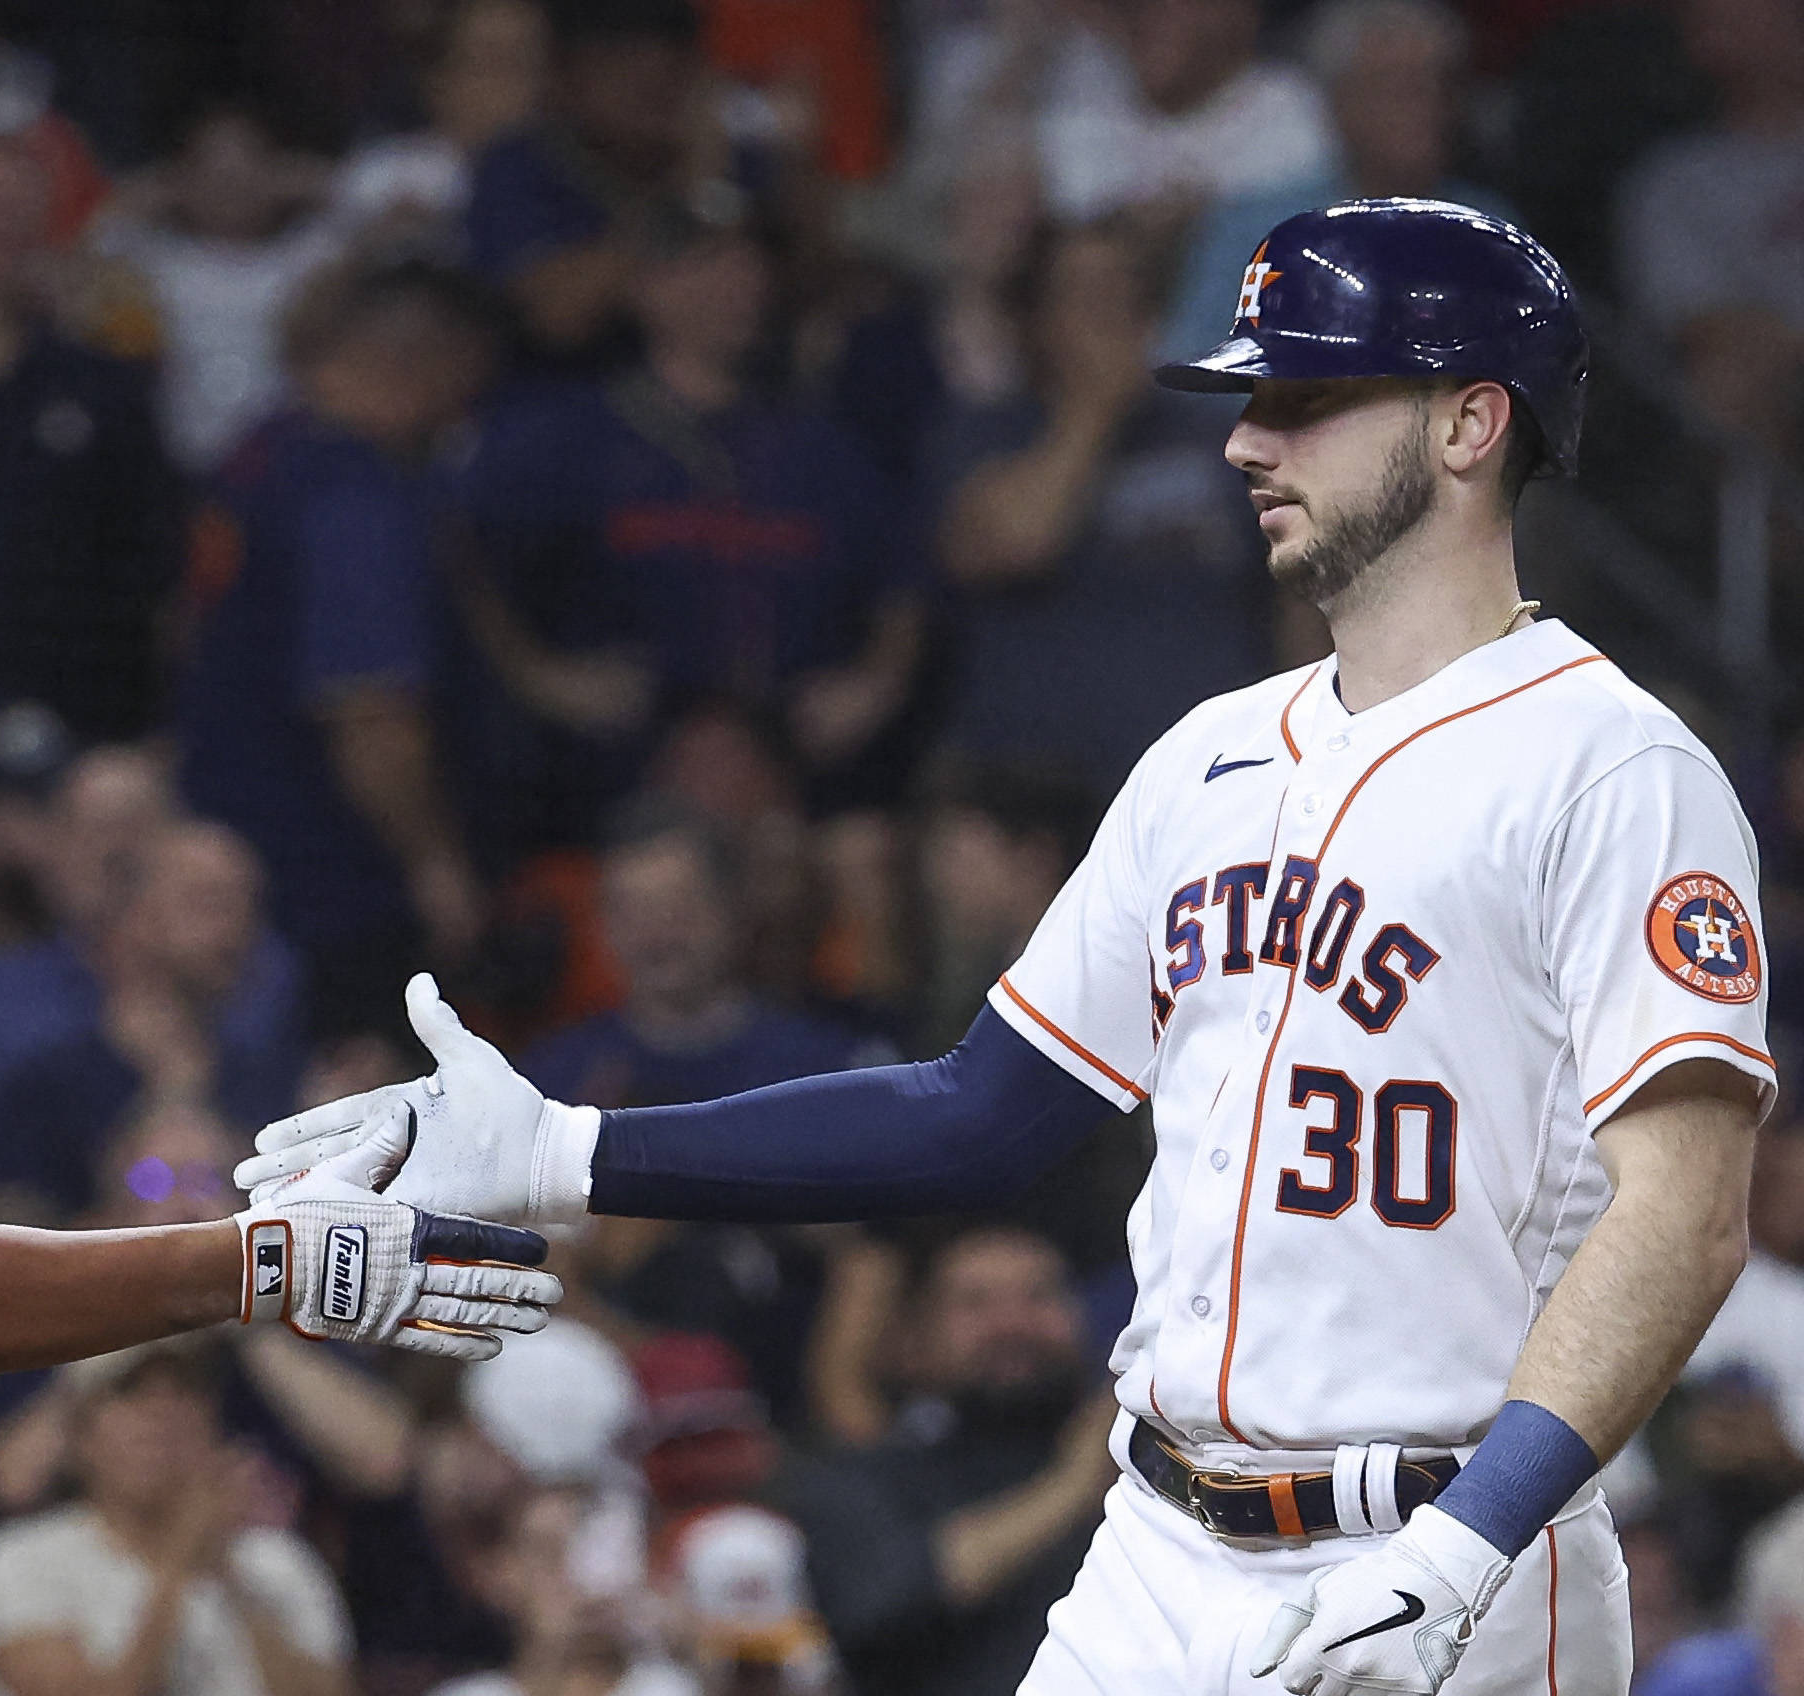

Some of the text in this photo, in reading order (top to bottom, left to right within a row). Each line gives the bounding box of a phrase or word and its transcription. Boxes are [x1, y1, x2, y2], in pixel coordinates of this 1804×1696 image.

[1148, 854, 1442, 1042] STROS
[1659, 880, 1746, 924] HOUSTON
[1675, 962, 1756, 995] ASTROS
[1276, 1063, 1458, 1230] 30
